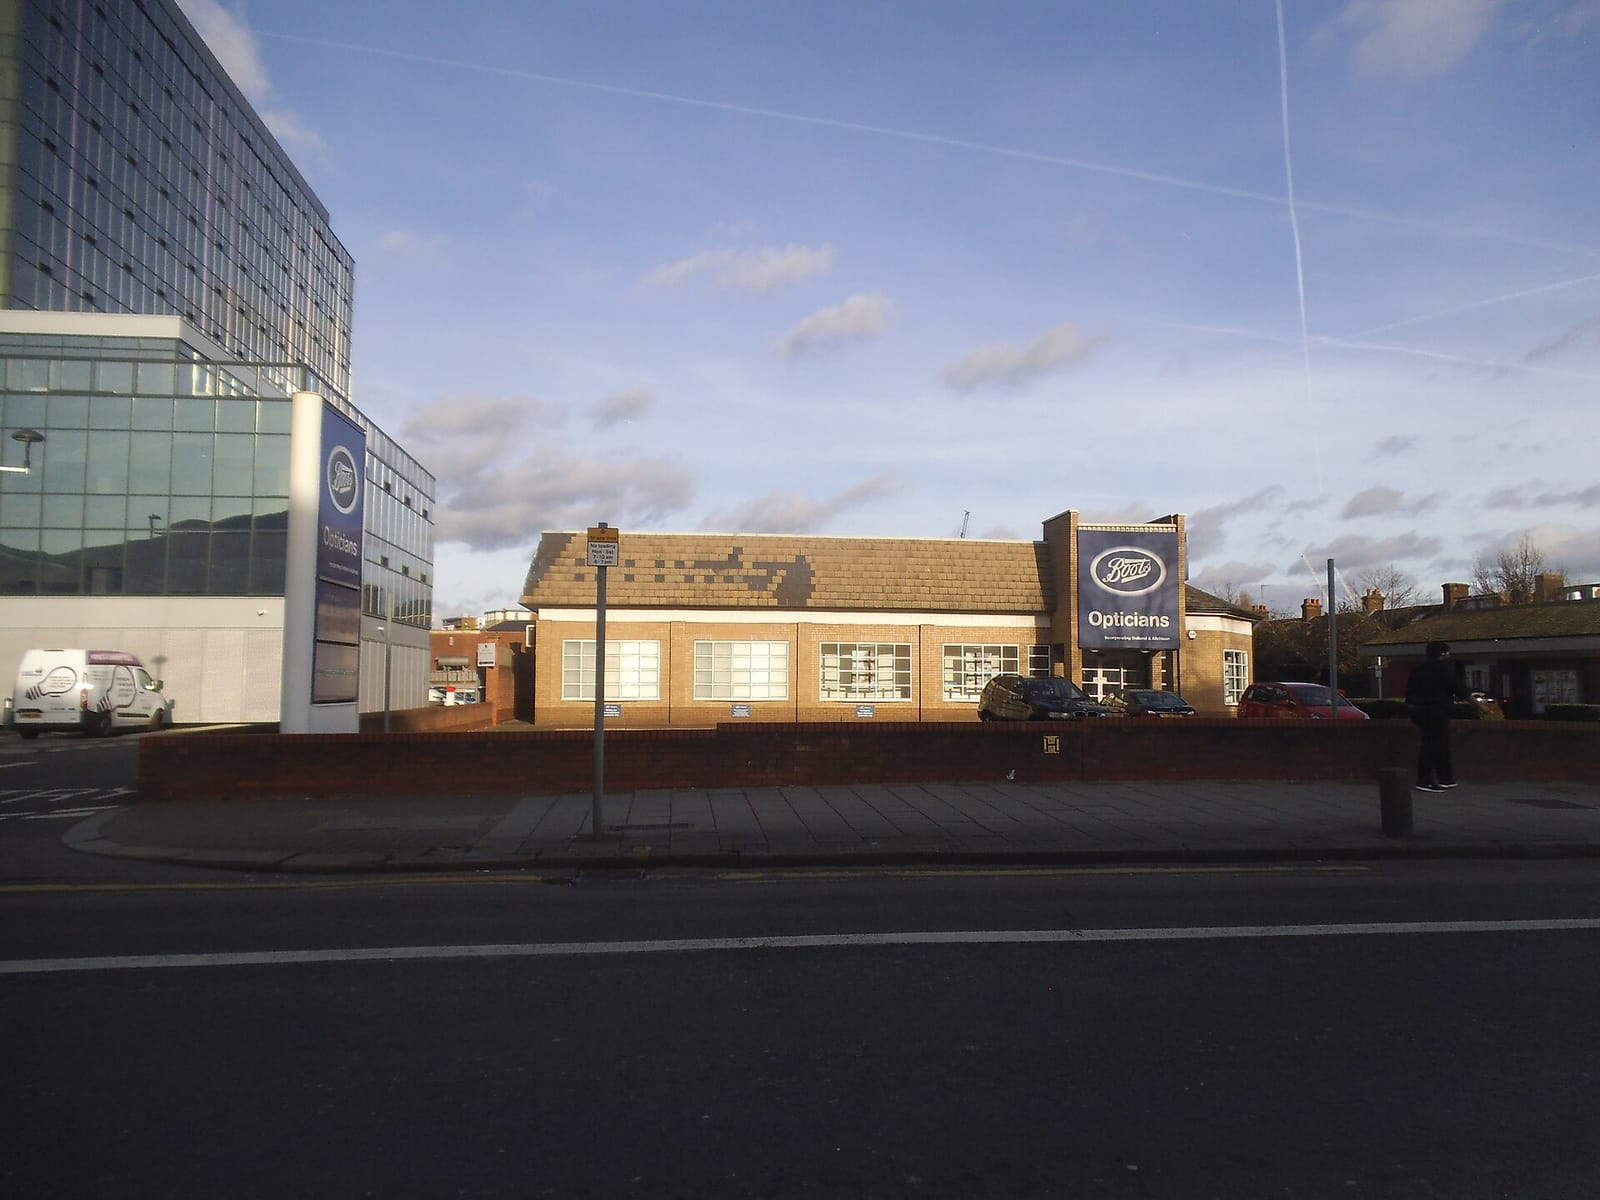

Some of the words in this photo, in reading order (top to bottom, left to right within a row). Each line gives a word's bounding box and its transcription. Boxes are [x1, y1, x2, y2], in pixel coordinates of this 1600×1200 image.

[331, 460, 353, 494] Boots
[323, 525, 358, 557] Opticians
[1101, 557, 1152, 583] Boots
[1088, 610, 1170, 629] Opticians
[1045, 736, 1058, 752] H
